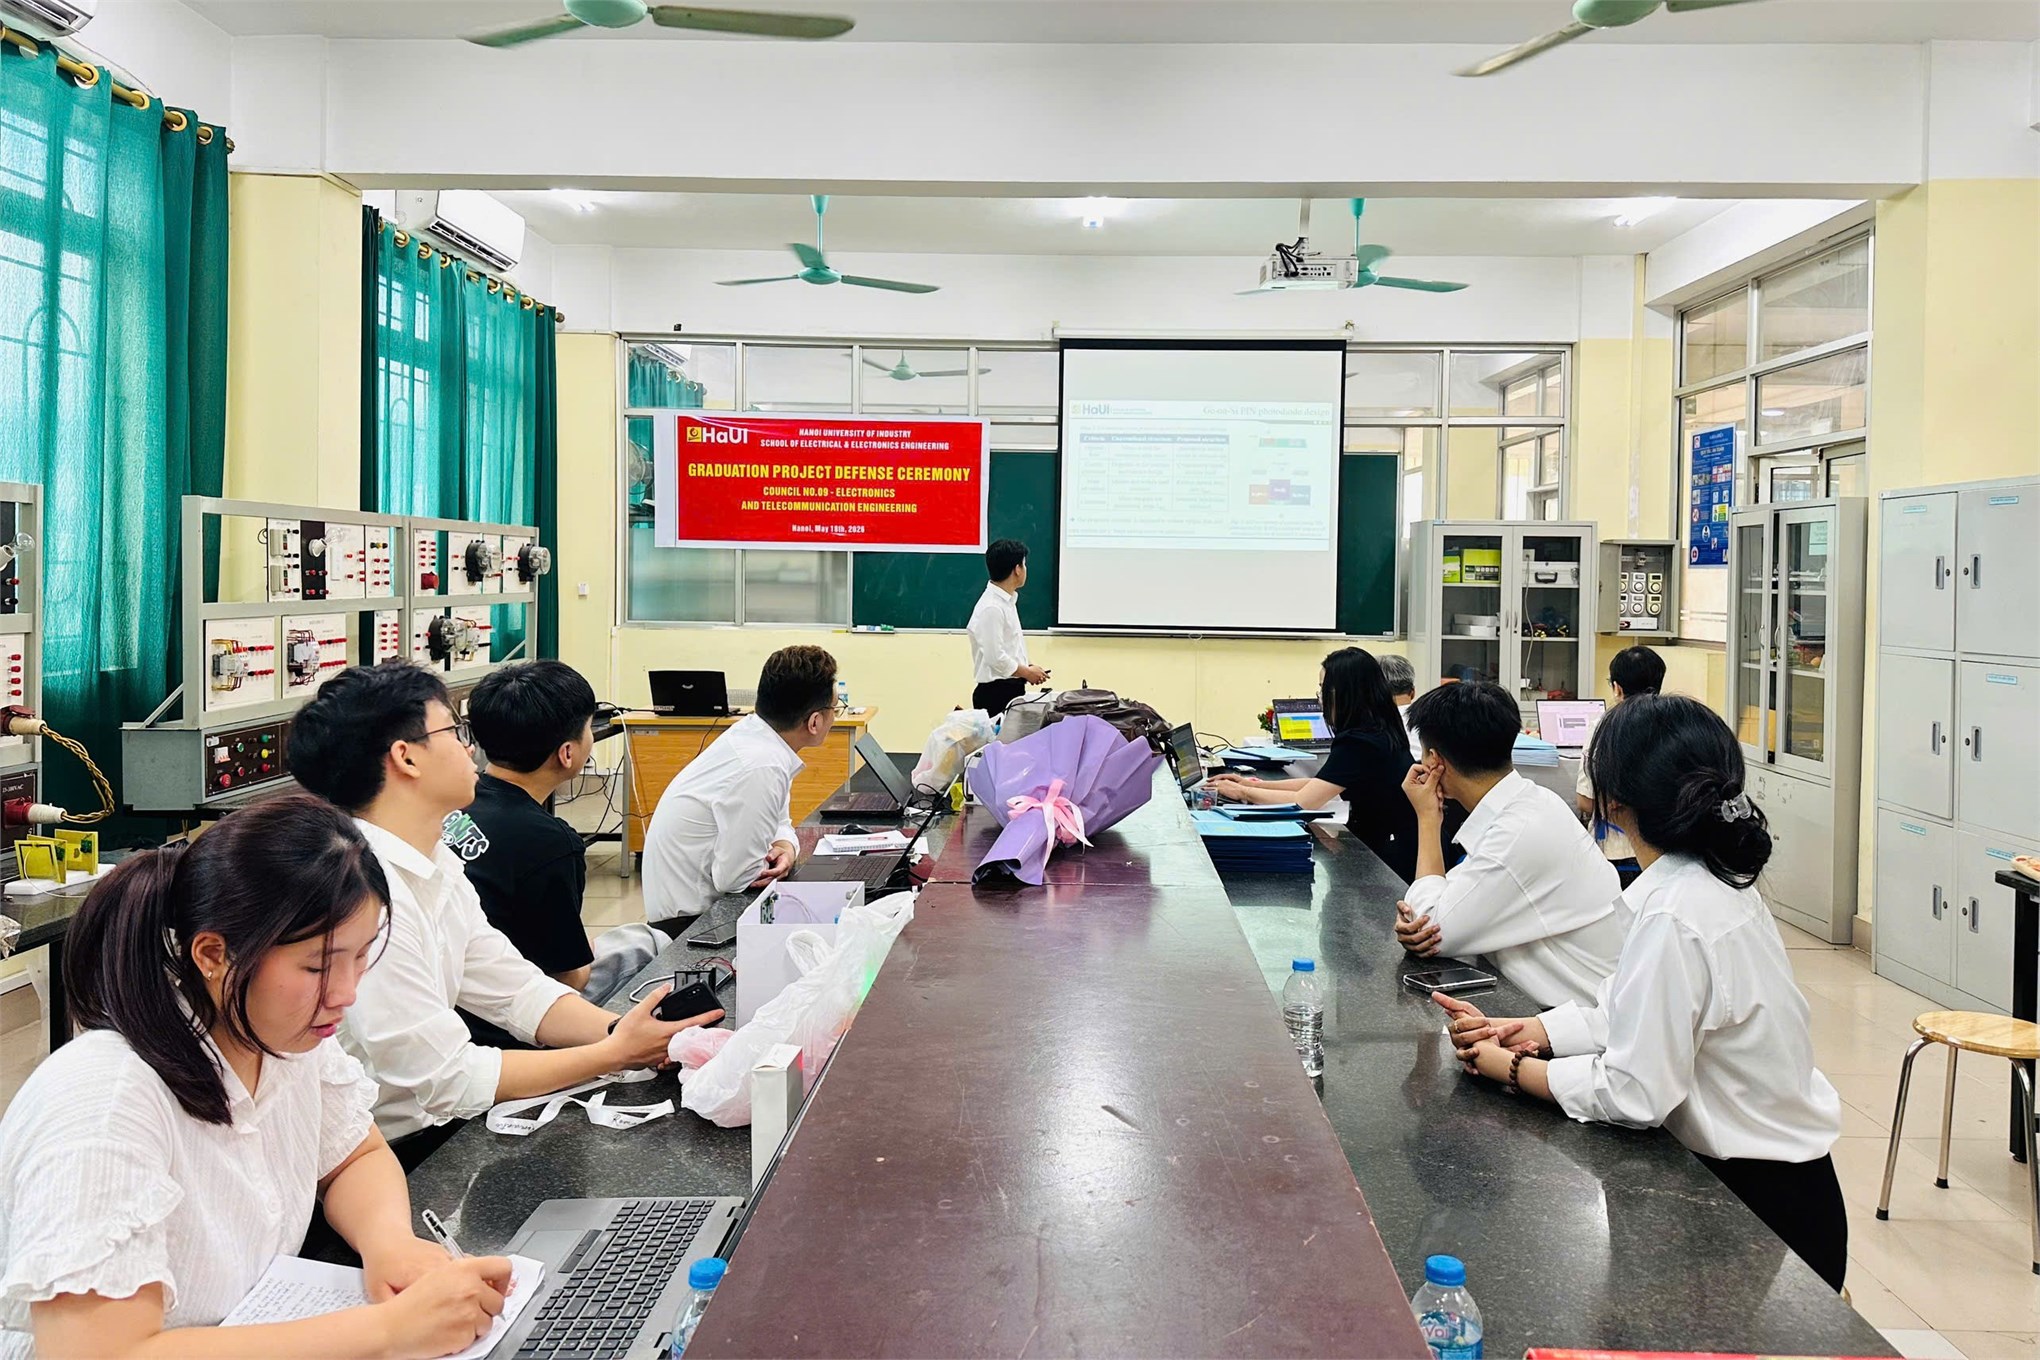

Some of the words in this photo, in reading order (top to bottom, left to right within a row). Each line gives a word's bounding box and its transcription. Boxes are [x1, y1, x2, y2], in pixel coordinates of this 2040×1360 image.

[1082, 404, 1110, 415] HaUI
[1304, 408, 1330, 418] design
[702, 427, 748, 444] HaUI
[799, 428, 822, 436] HANOI
[876, 430, 912, 438] INDUSTRY
[760, 439, 789, 448] SCHOOL
[790, 440, 799, 448] OF
[800, 440, 842, 449] ELECTRICAL
[851, 441, 899, 449] ELECTRONICS
[900, 442, 950, 451] ENGINEERING
[688, 463, 769, 478] GRADUATION
[772, 464, 832, 479] PROJECT
[835, 465, 894, 480] DEFENSE
[897, 467, 971, 482] CEREMONY
[763, 486, 801, 497] COUNCIL
[803, 487, 829, 497] NO.09
[836, 488, 896, 498] ELECTRONICS
[741, 501, 760, 511] AND
[761, 501, 856, 512] TELECOMMUNICATION
[857, 503, 918, 513] ENGINEERING
[792, 524, 814, 533] Hanoi,
[814, 525, 829, 534] May
[848, 525, 865, 534] 2026
